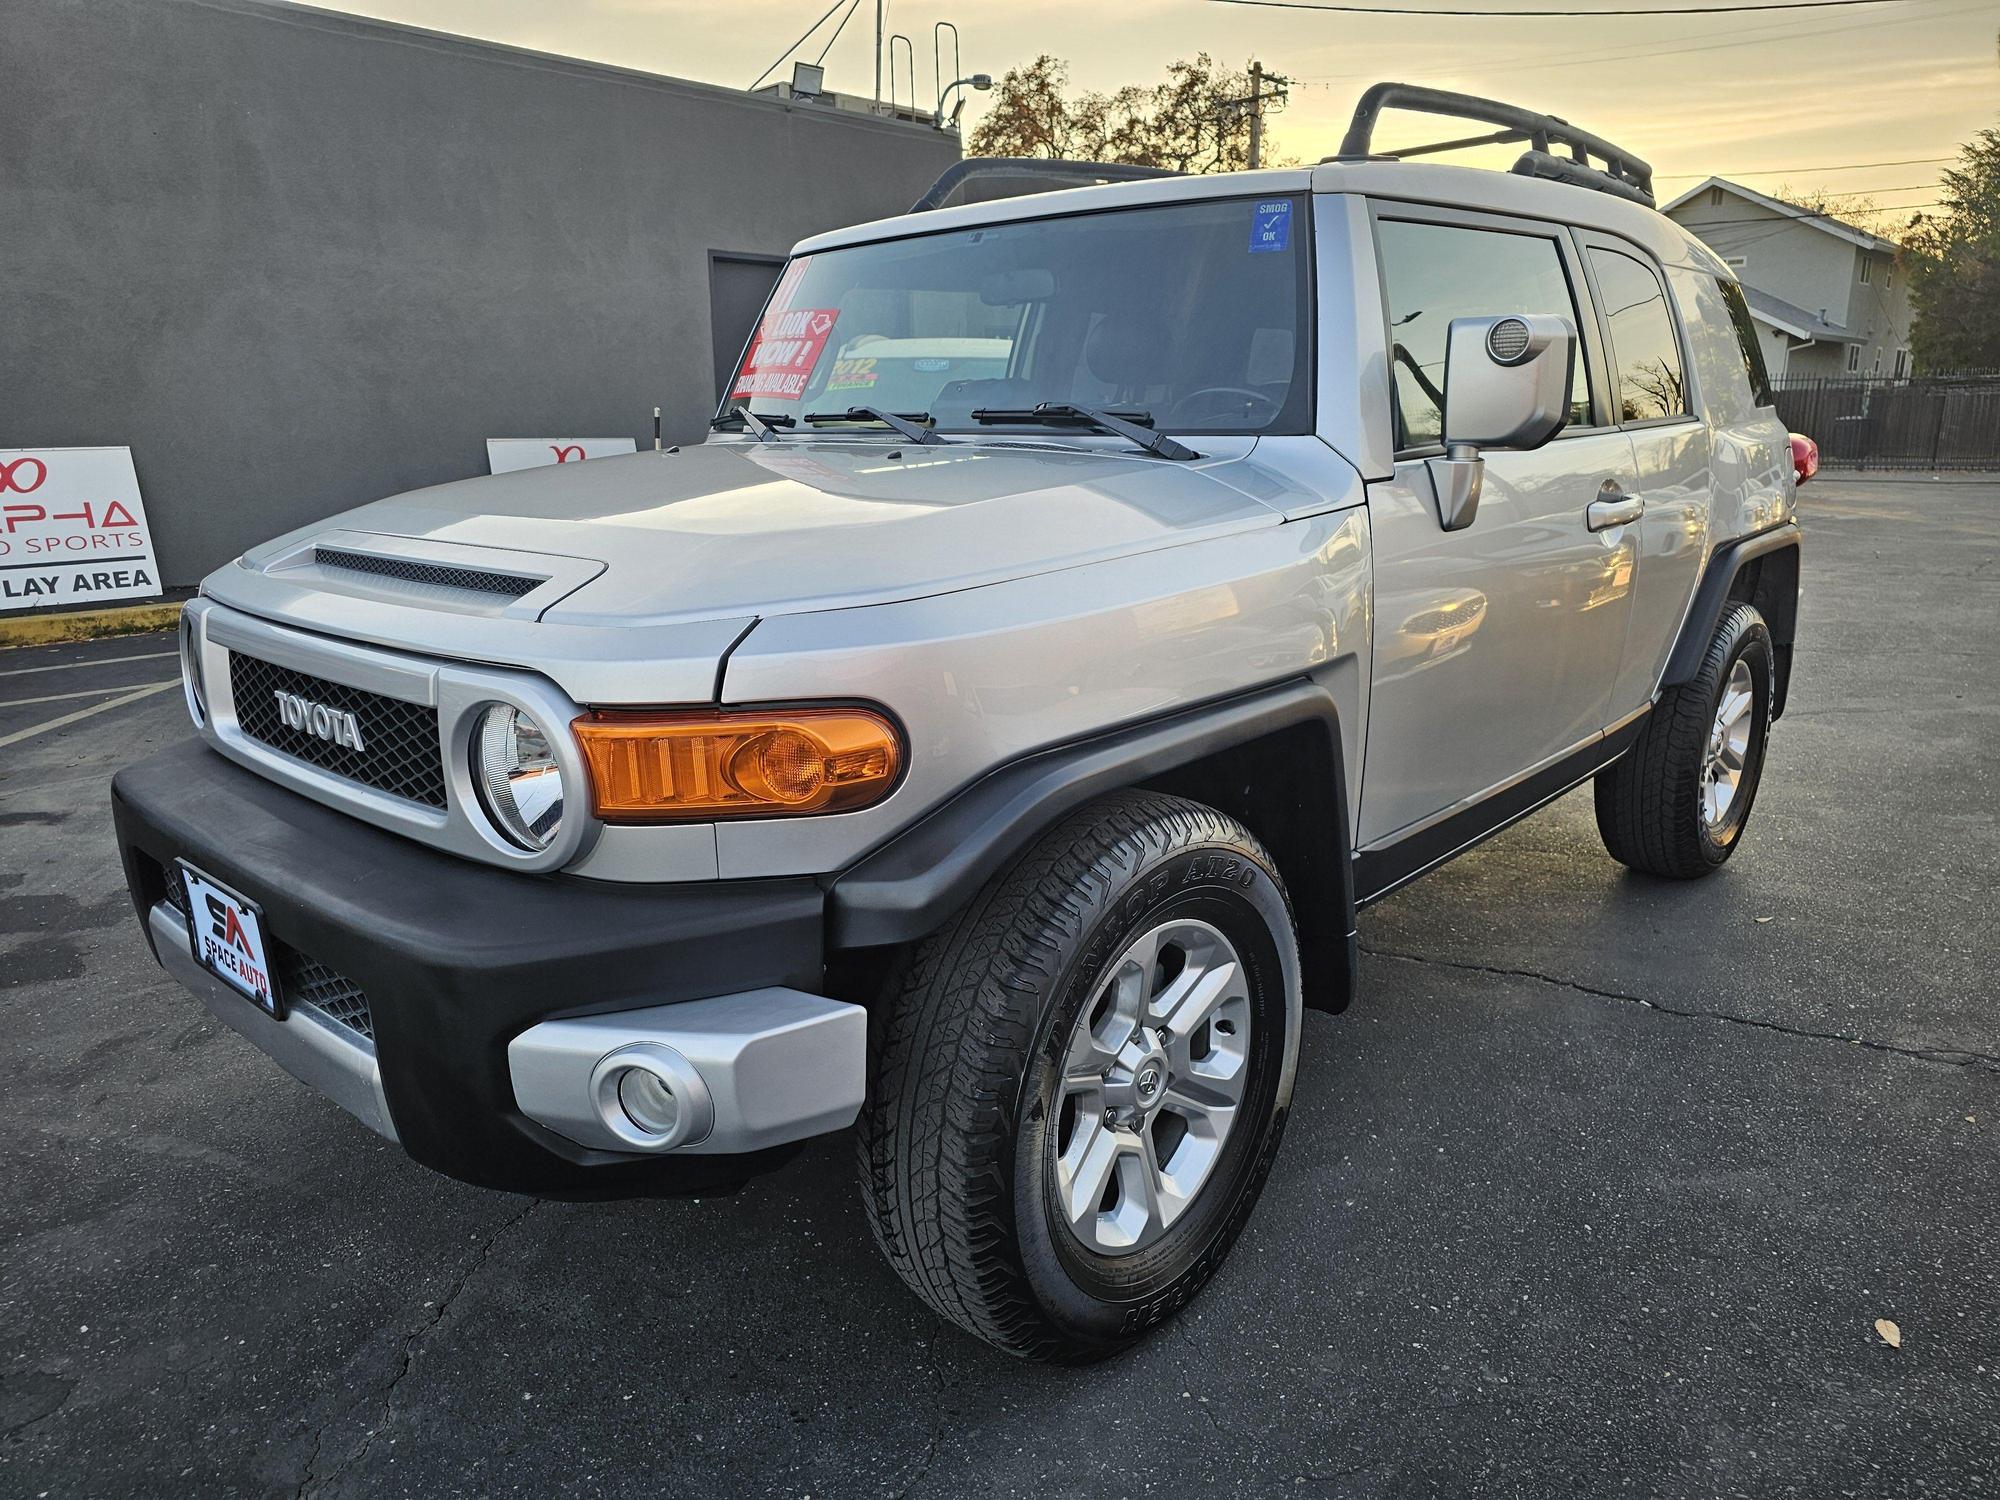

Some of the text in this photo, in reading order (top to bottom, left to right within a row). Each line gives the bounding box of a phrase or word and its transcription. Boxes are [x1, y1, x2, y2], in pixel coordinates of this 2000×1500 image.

[1260, 203, 1288, 213] SMOG
[1262, 232, 1276, 241] OK
[770, 311, 815, 338] LOOK
[0, 501, 138, 533] PHA
[26, 532, 143, 554] SPORTS
[73, 569, 152, 592] AREA
[274, 690, 365, 752] TOYOTA
[1181, 855, 1257, 889] AT20
[205, 935, 267, 994] SPACE AUTO
